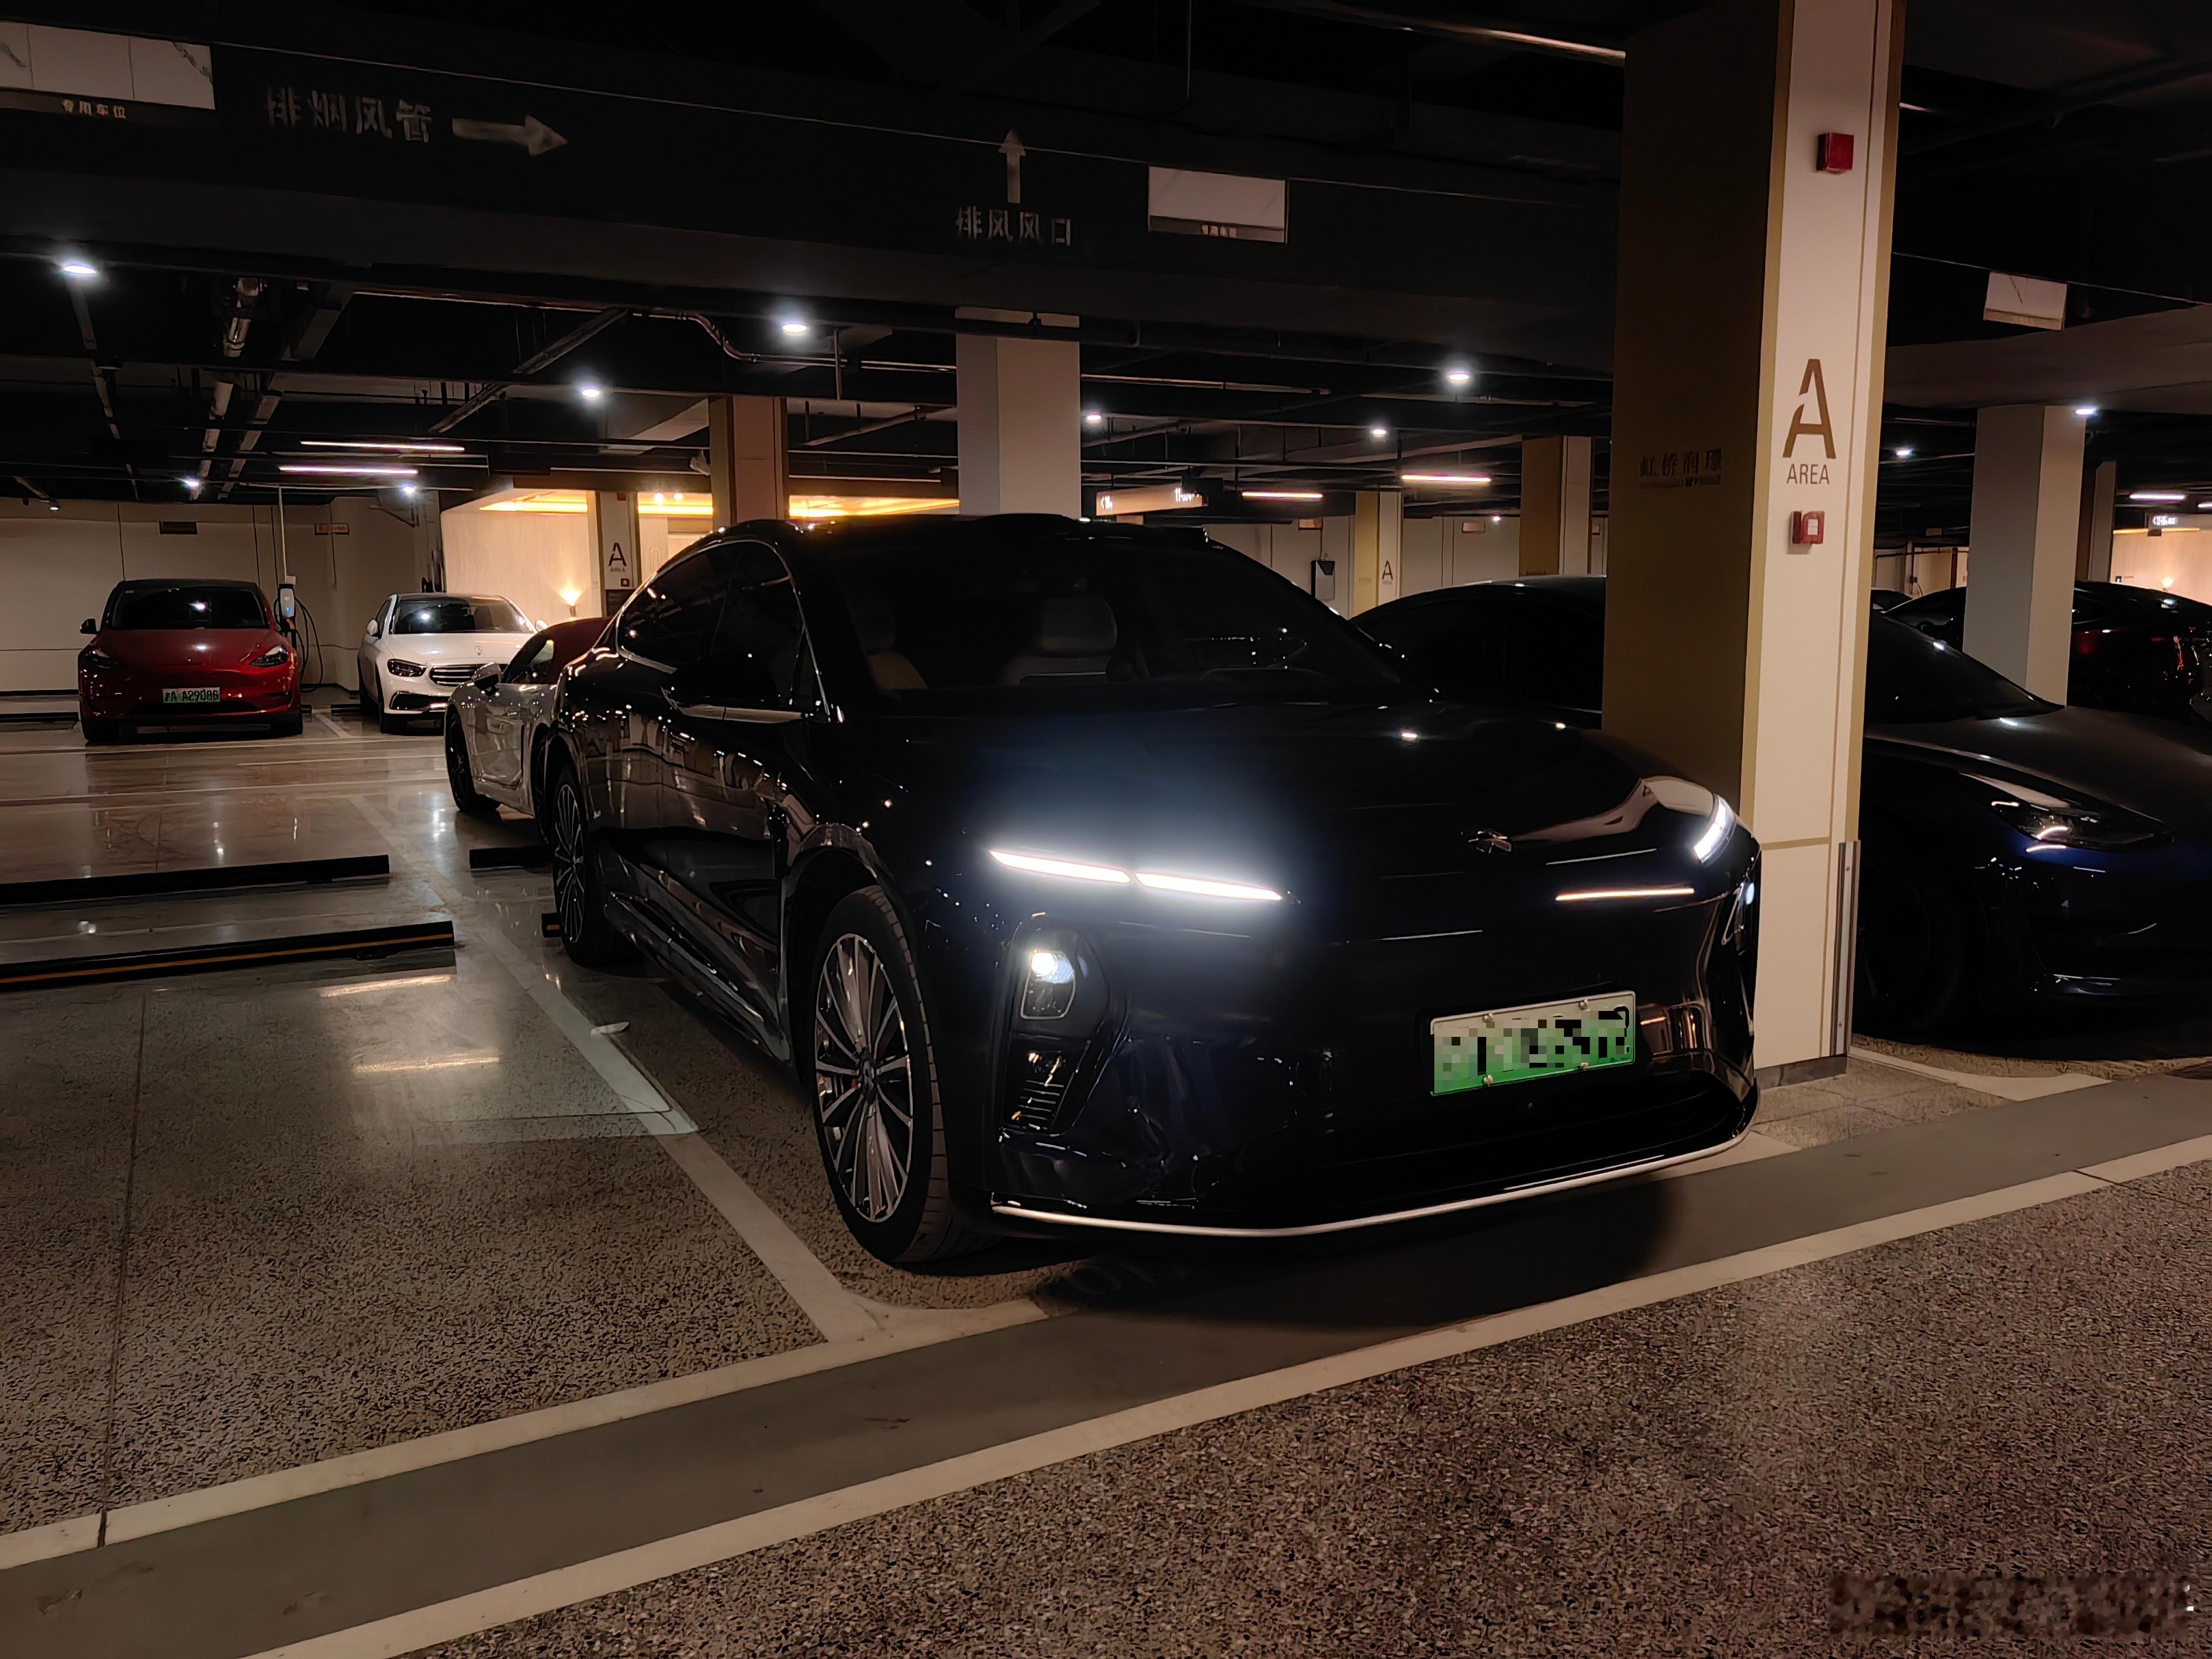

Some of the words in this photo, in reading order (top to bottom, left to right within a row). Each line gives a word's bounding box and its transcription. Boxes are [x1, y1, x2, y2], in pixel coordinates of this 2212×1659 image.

[955, 205, 1071, 247] 排风风口
[1782, 359, 1836, 459] A
[1786, 463, 1830, 484] AREA
[608, 542, 627, 567] A
[1381, 560, 1393, 580] A
